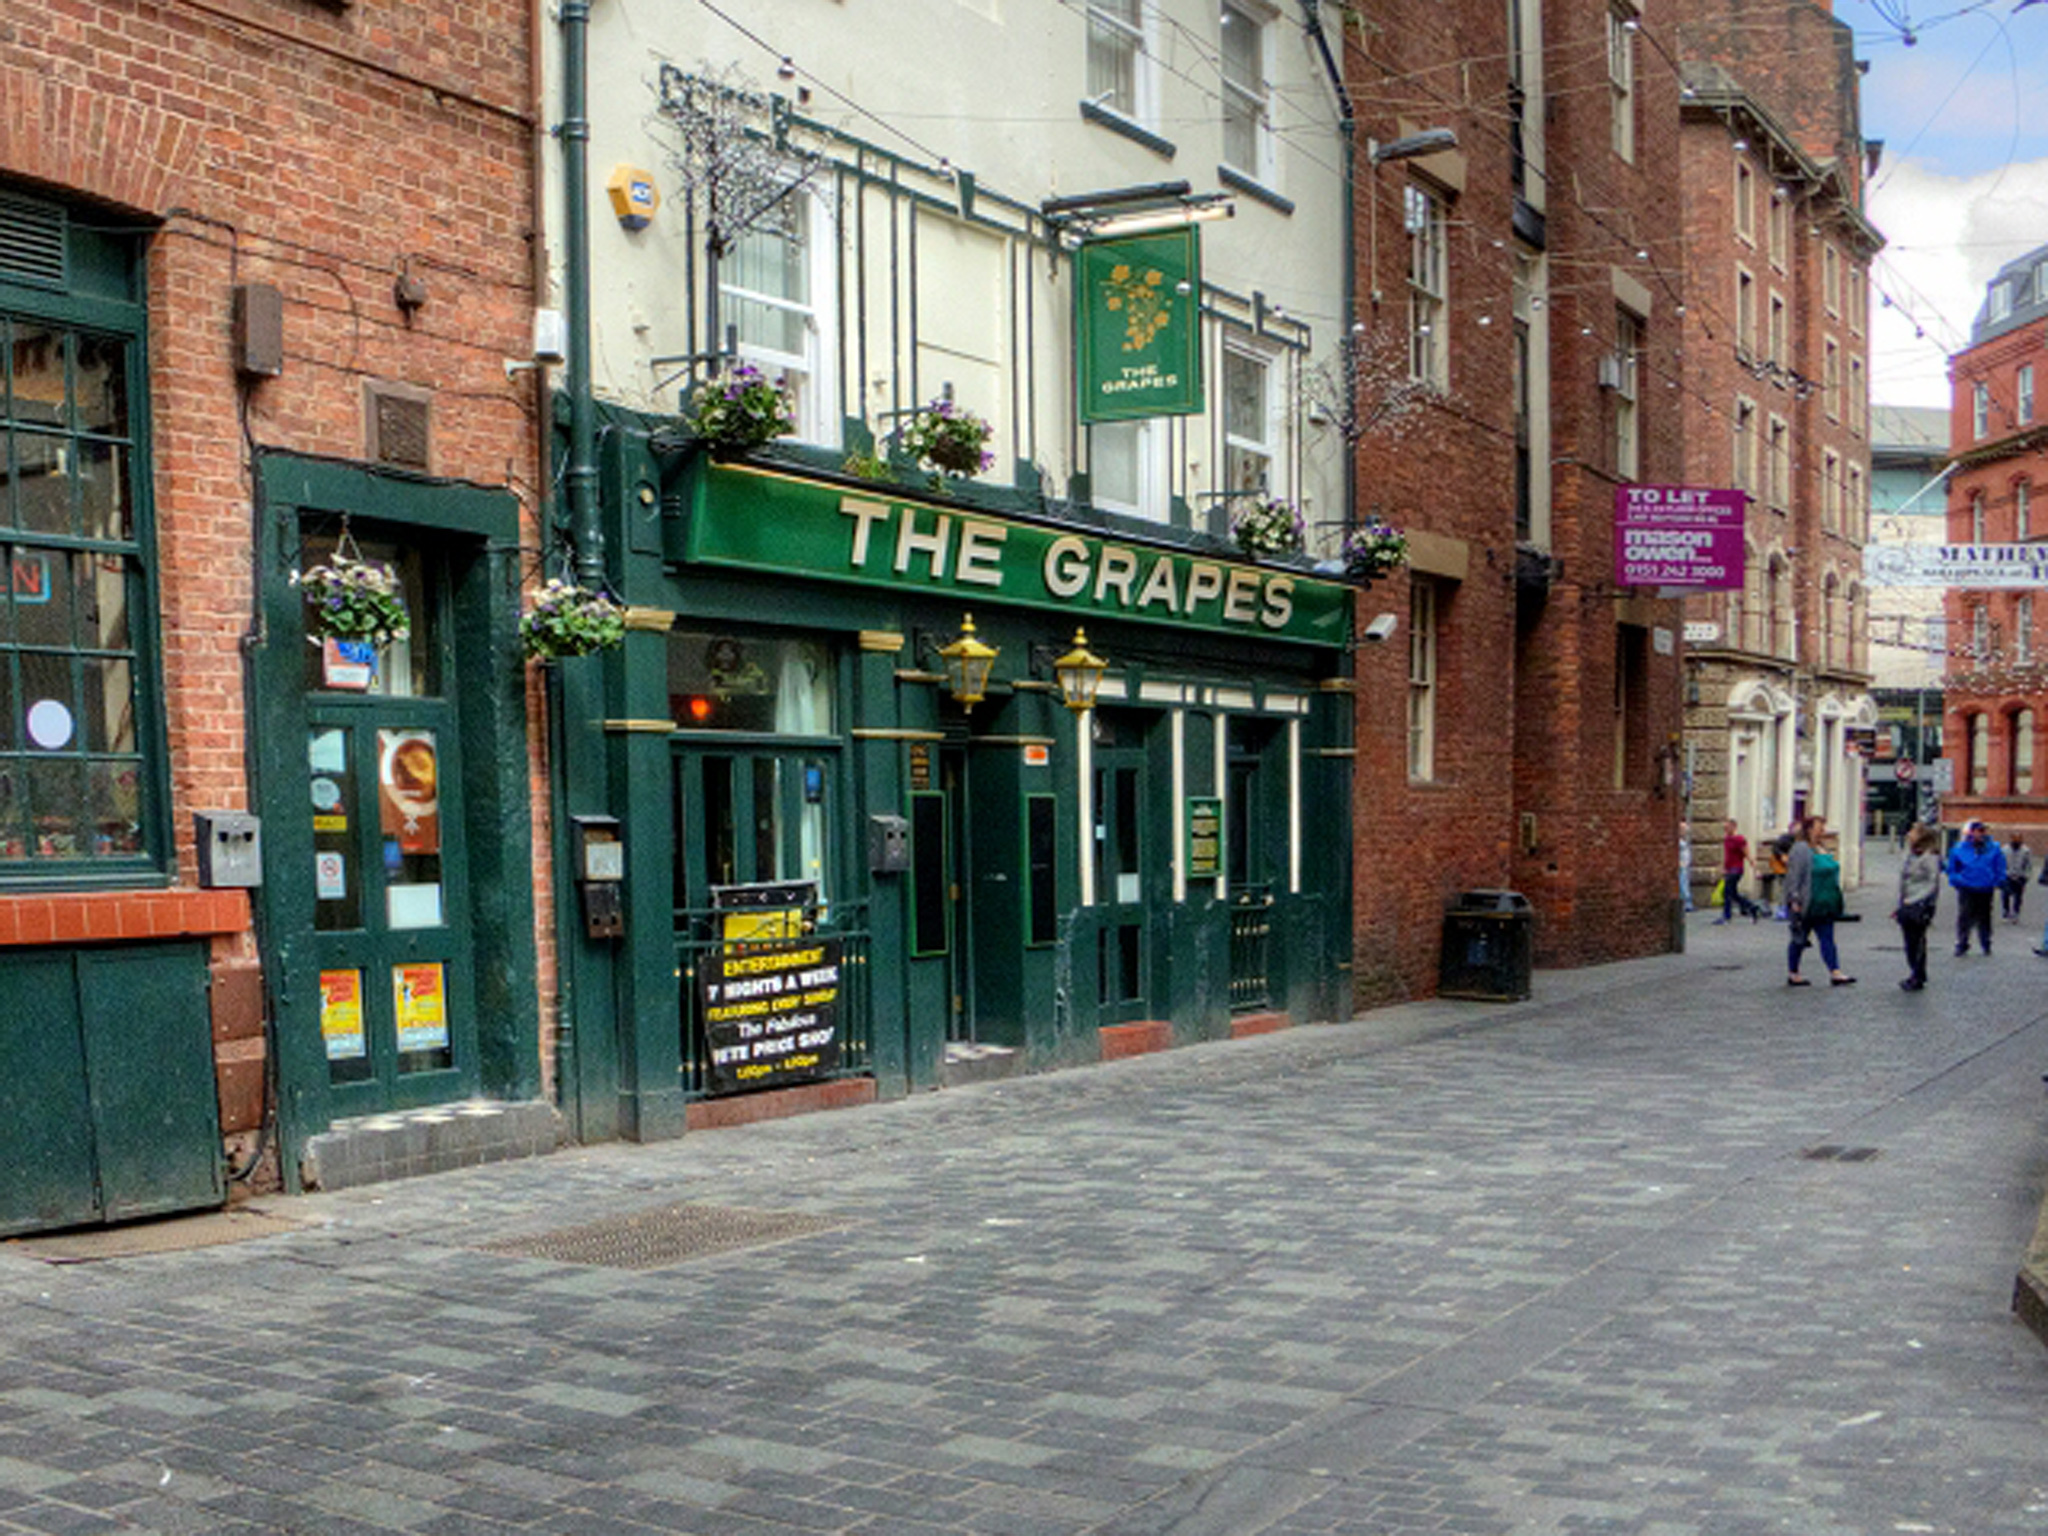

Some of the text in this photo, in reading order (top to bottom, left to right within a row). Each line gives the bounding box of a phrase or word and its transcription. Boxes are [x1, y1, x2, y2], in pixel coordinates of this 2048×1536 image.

[1121, 364, 1158, 379] THE
[1101, 374, 1178, 394] GRAPES
[1628, 489, 1711, 503] TO LET
[1625, 529, 1713, 547] mason
[1625, 546, 1697, 561] owen
[839, 496, 1297, 629] THE GRAPES
[724, 975, 783, 999] NIGHTS
[785, 974, 798, 990] A
[739, 1022, 763, 1037] The
